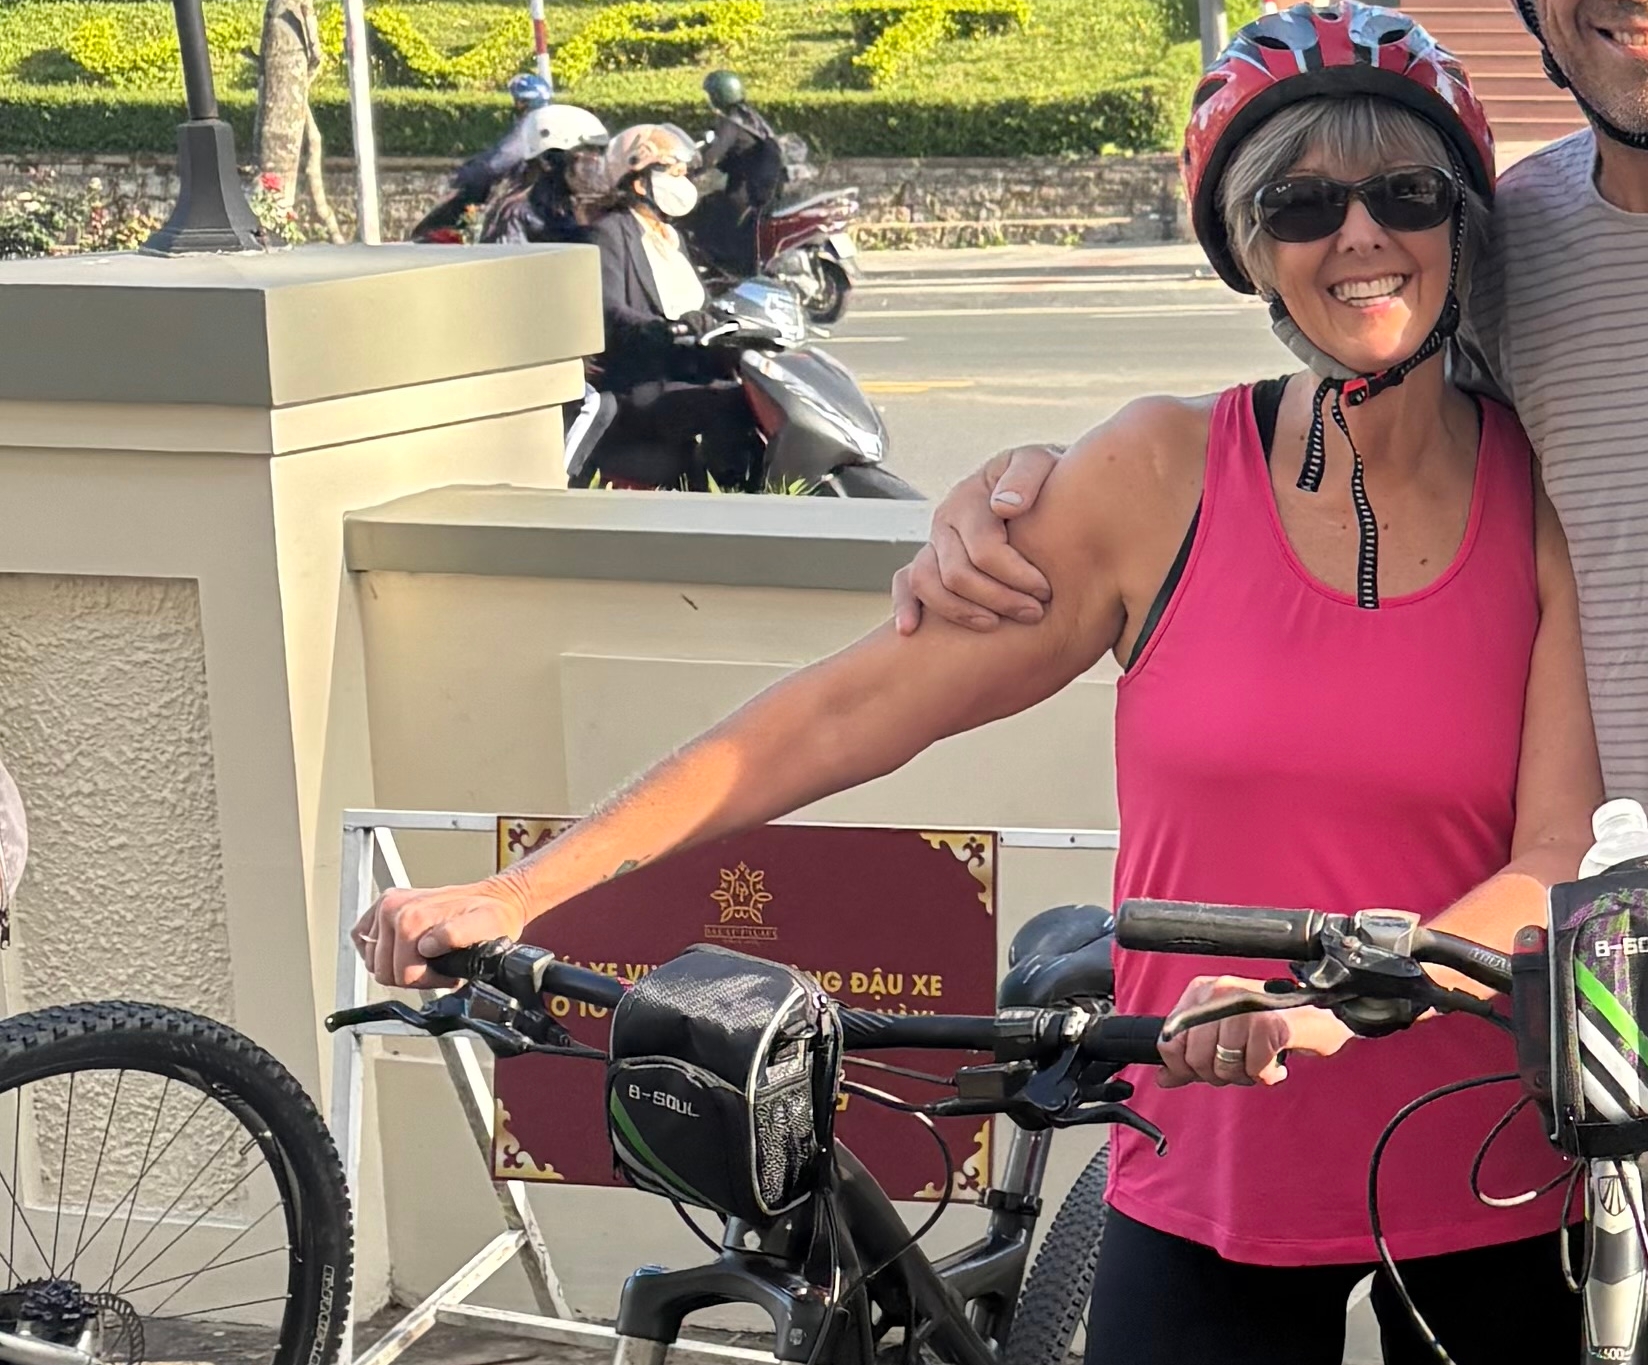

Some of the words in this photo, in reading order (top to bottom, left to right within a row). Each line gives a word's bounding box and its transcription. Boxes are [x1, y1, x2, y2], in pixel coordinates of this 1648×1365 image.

[850, 967, 904, 1001] ĐẬU
[911, 974, 943, 997] XE
[628, 1084, 701, 1118] B-SOUL
